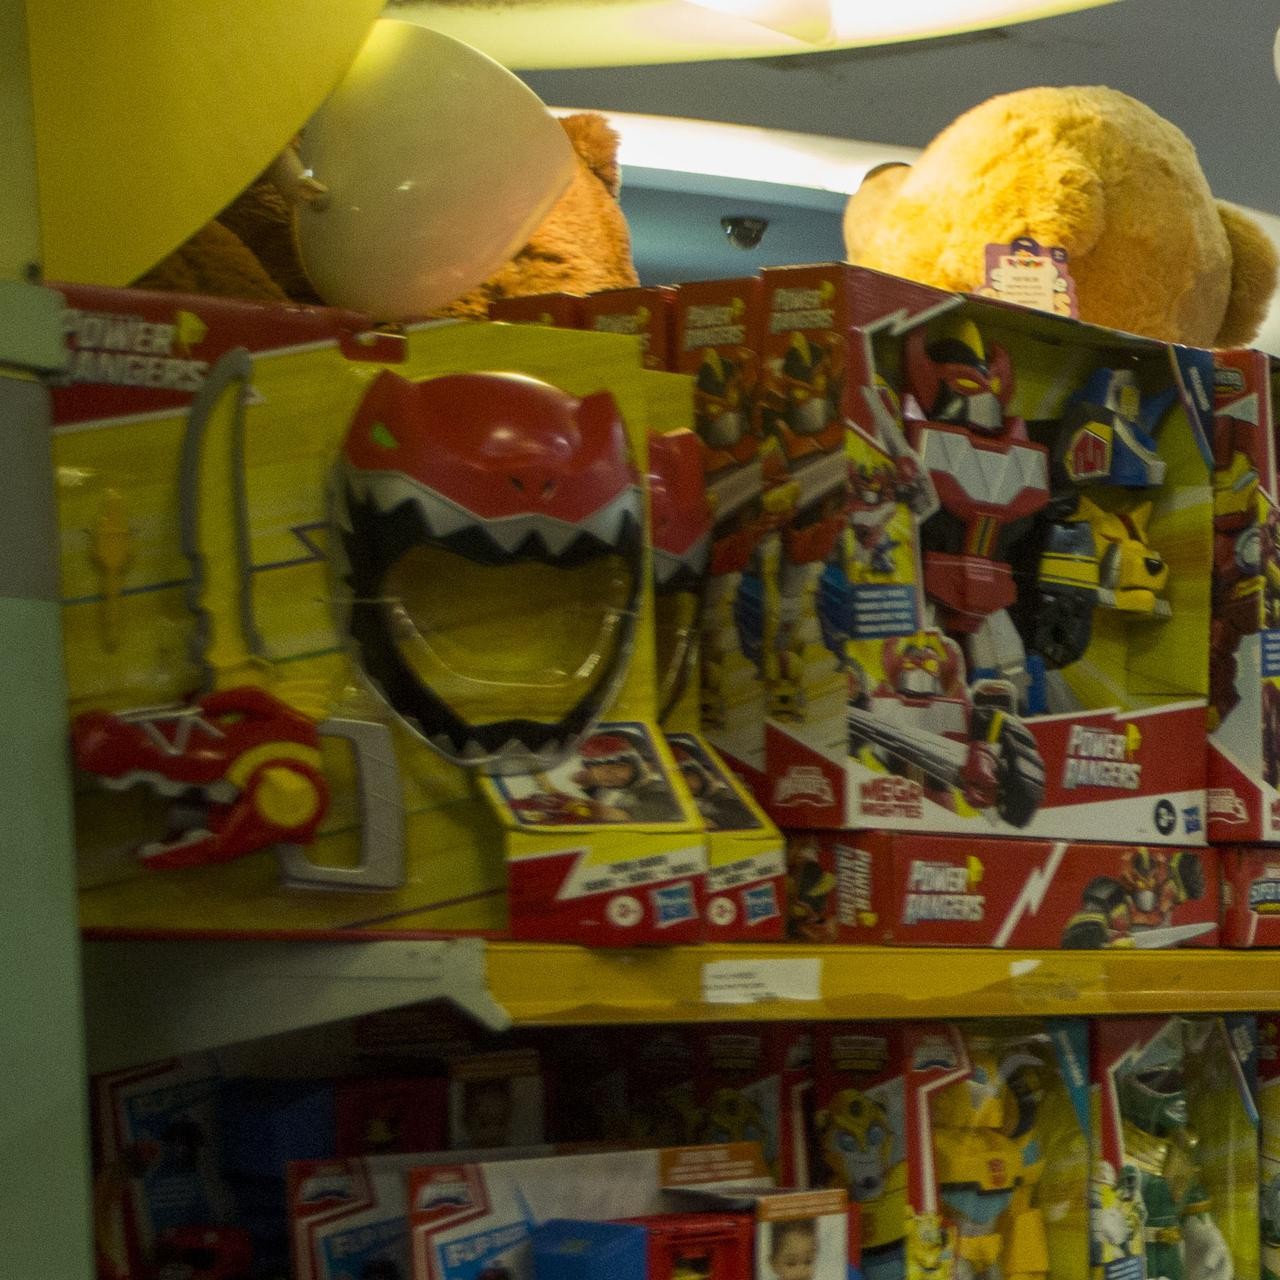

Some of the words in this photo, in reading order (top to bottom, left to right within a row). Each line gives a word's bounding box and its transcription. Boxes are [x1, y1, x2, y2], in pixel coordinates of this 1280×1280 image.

[62, 308, 177, 356] POWER
[1067, 723, 1127, 760] POWER
[1062, 757, 1142, 790] RANGERS
[908, 860, 970, 894] POWER
[903, 891, 986, 925] RANGERS
